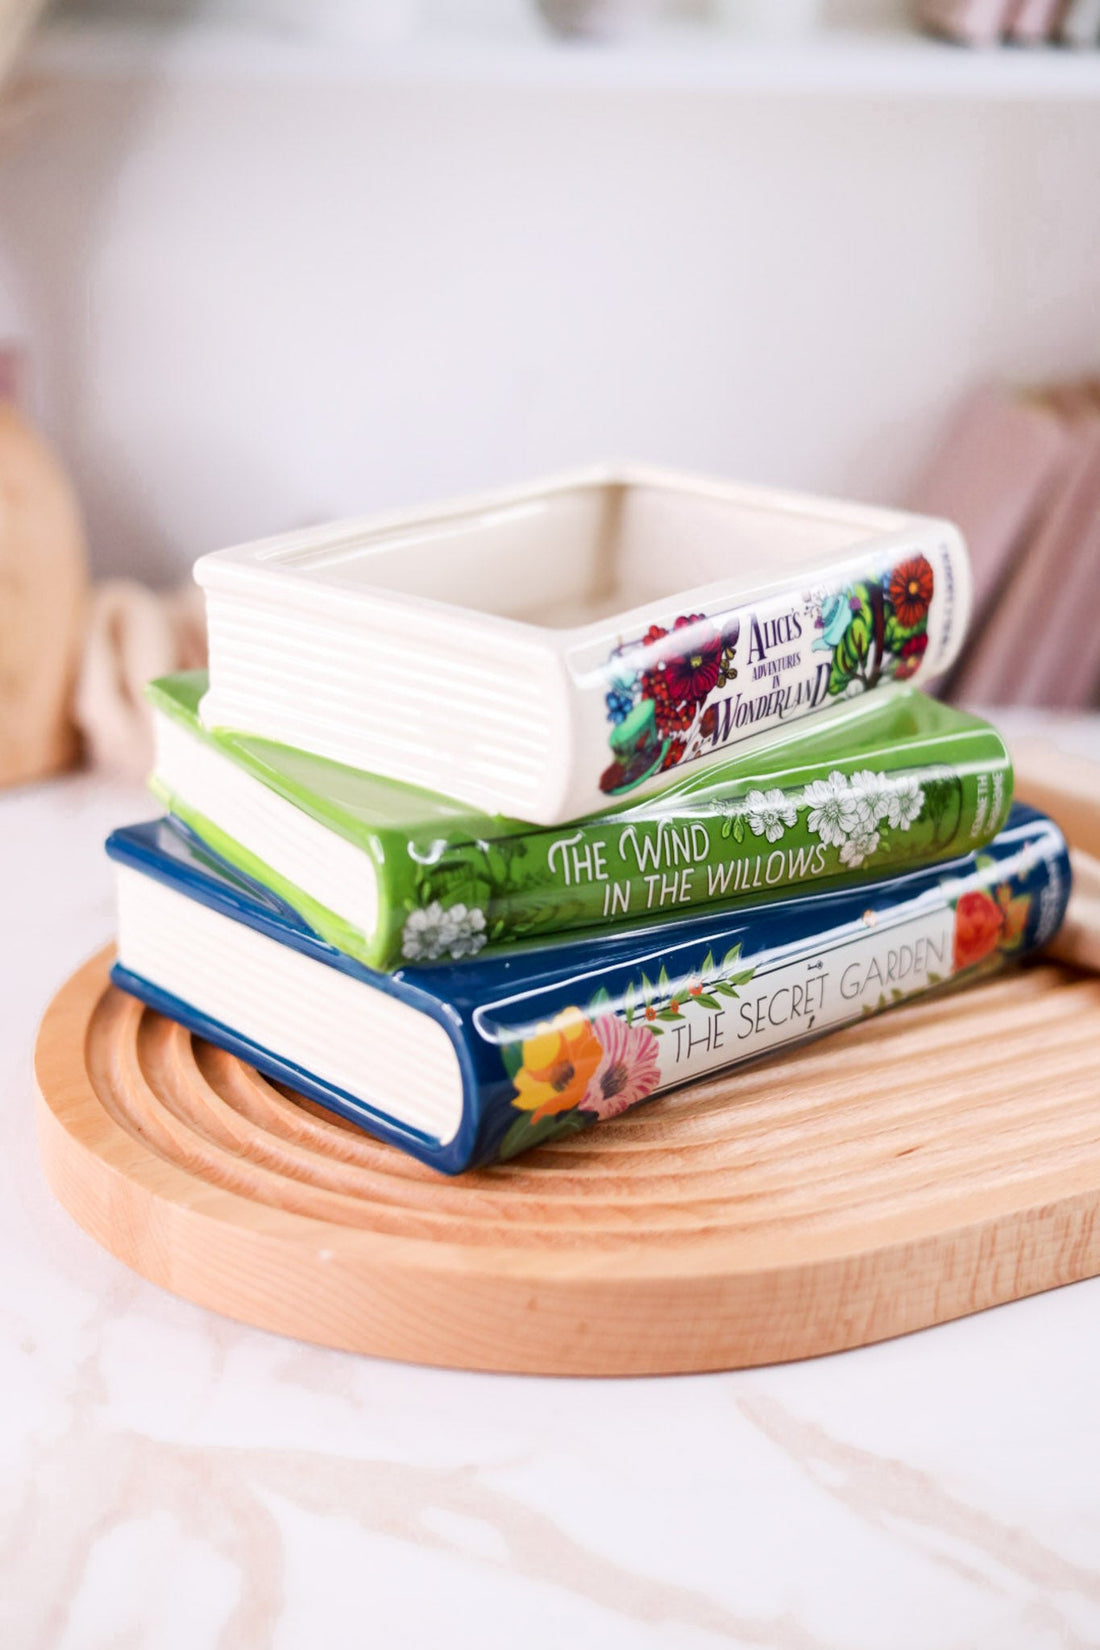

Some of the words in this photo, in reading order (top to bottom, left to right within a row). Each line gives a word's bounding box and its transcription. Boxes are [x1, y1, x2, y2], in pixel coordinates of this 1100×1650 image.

[747, 608, 802, 665] ALICE'S
[752, 652, 801, 682] ADVENTURES
[711, 662, 832, 746] WONDERLAND
[772, 674, 781, 689] IN
[548, 829, 609, 886] THE
[619, 815, 710, 873] WIND
[603, 880, 631, 917] IN
[644, 868, 694, 908] THE
[707, 843, 827, 896] WILLOWS
[671, 1011, 726, 1063] THE
[737, 973, 829, 1040] SECRET
[840, 931, 948, 1000] GARDEN
